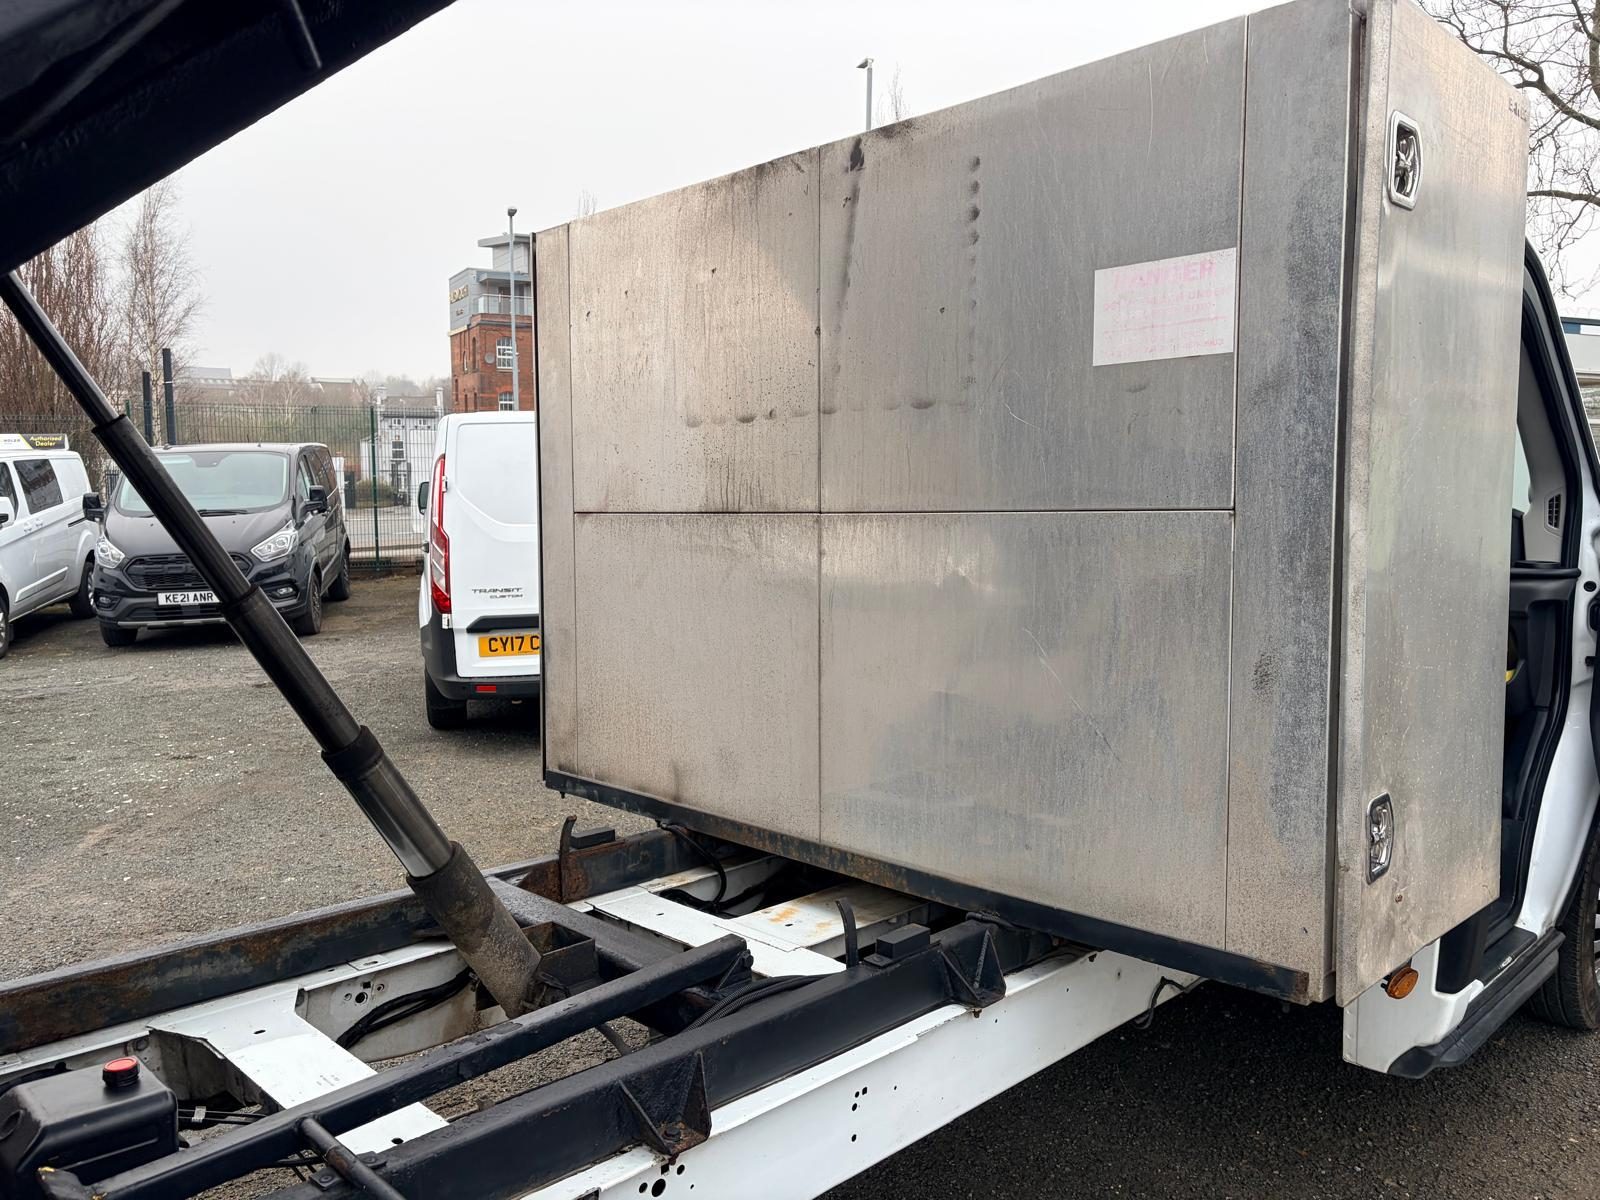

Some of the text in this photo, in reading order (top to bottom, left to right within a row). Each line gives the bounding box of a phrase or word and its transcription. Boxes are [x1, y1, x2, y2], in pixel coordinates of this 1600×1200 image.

[165, 592, 214, 603] KE21 ANR
[488, 635, 525, 653] CY17
